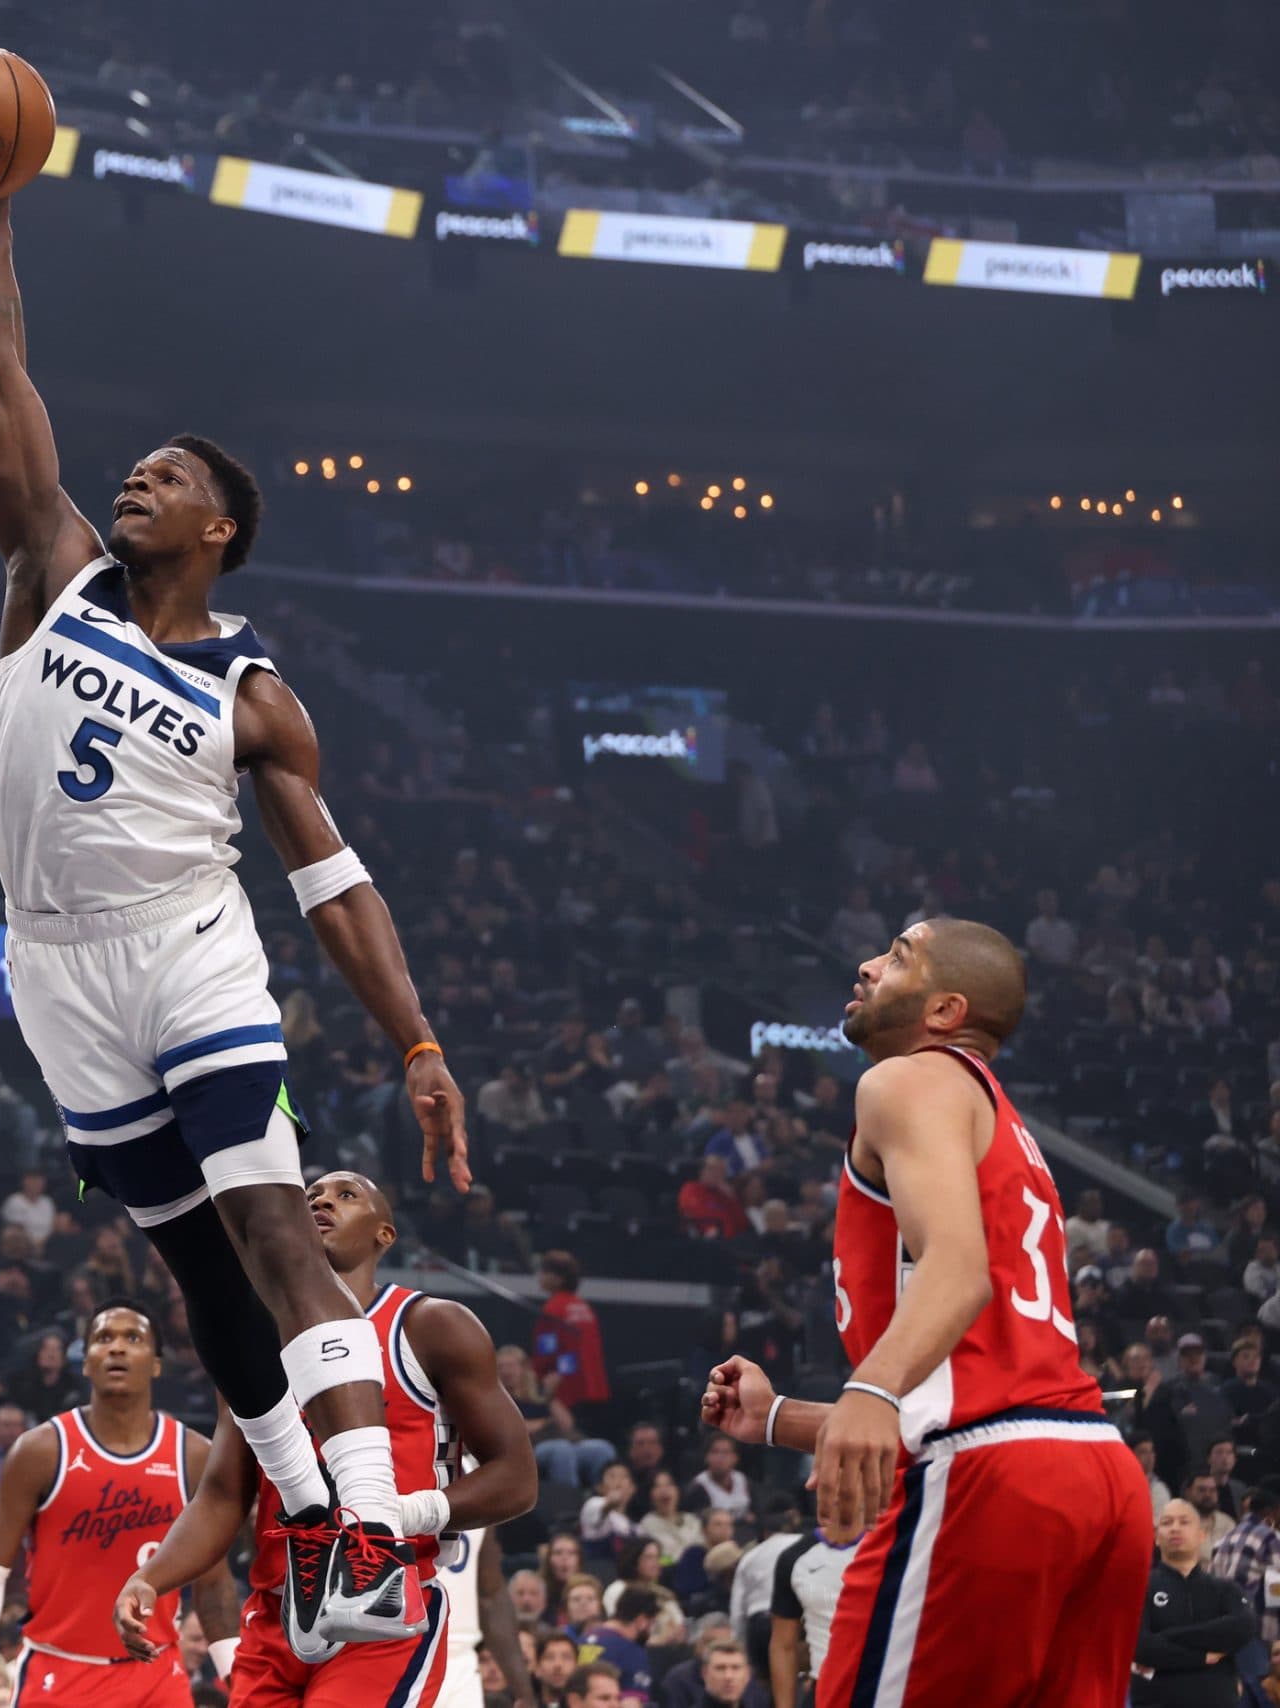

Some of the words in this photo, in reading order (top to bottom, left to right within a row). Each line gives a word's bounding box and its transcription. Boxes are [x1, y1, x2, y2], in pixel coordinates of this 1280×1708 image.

[436, 211, 529, 240] peacock
[804, 240, 895, 271] peacock
[1161, 263, 1256, 295] peacock
[41, 647, 206, 757] WOLVES
[57, 716, 124, 802] 5
[320, 1338, 350, 1362] 5
[95, 1479, 143, 1513] Los
[61, 1499, 173, 1549] Angeles
